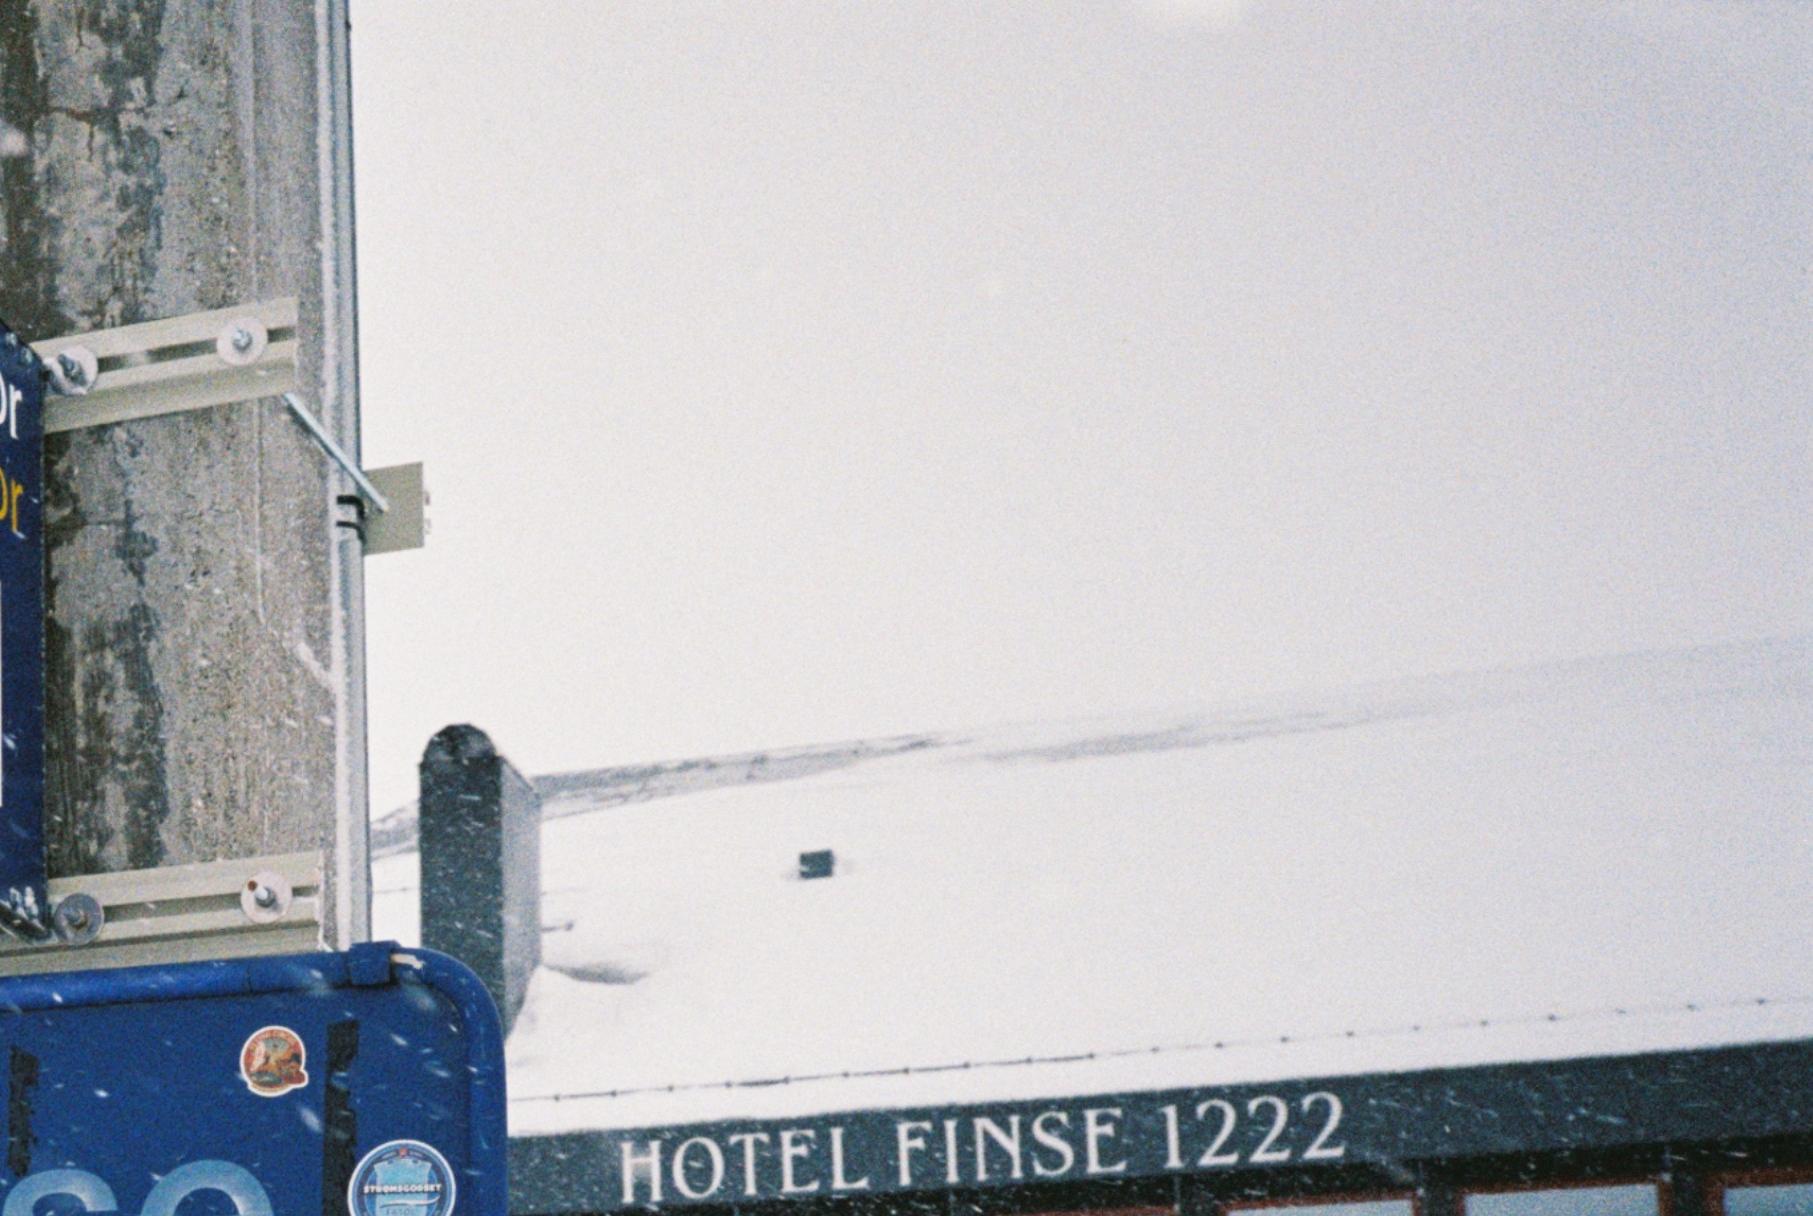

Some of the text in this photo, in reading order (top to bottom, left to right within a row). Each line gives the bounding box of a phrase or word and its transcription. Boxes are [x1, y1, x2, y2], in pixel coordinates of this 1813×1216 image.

[621, 1091, 1345, 1204] HOTEL FINSE 1222
